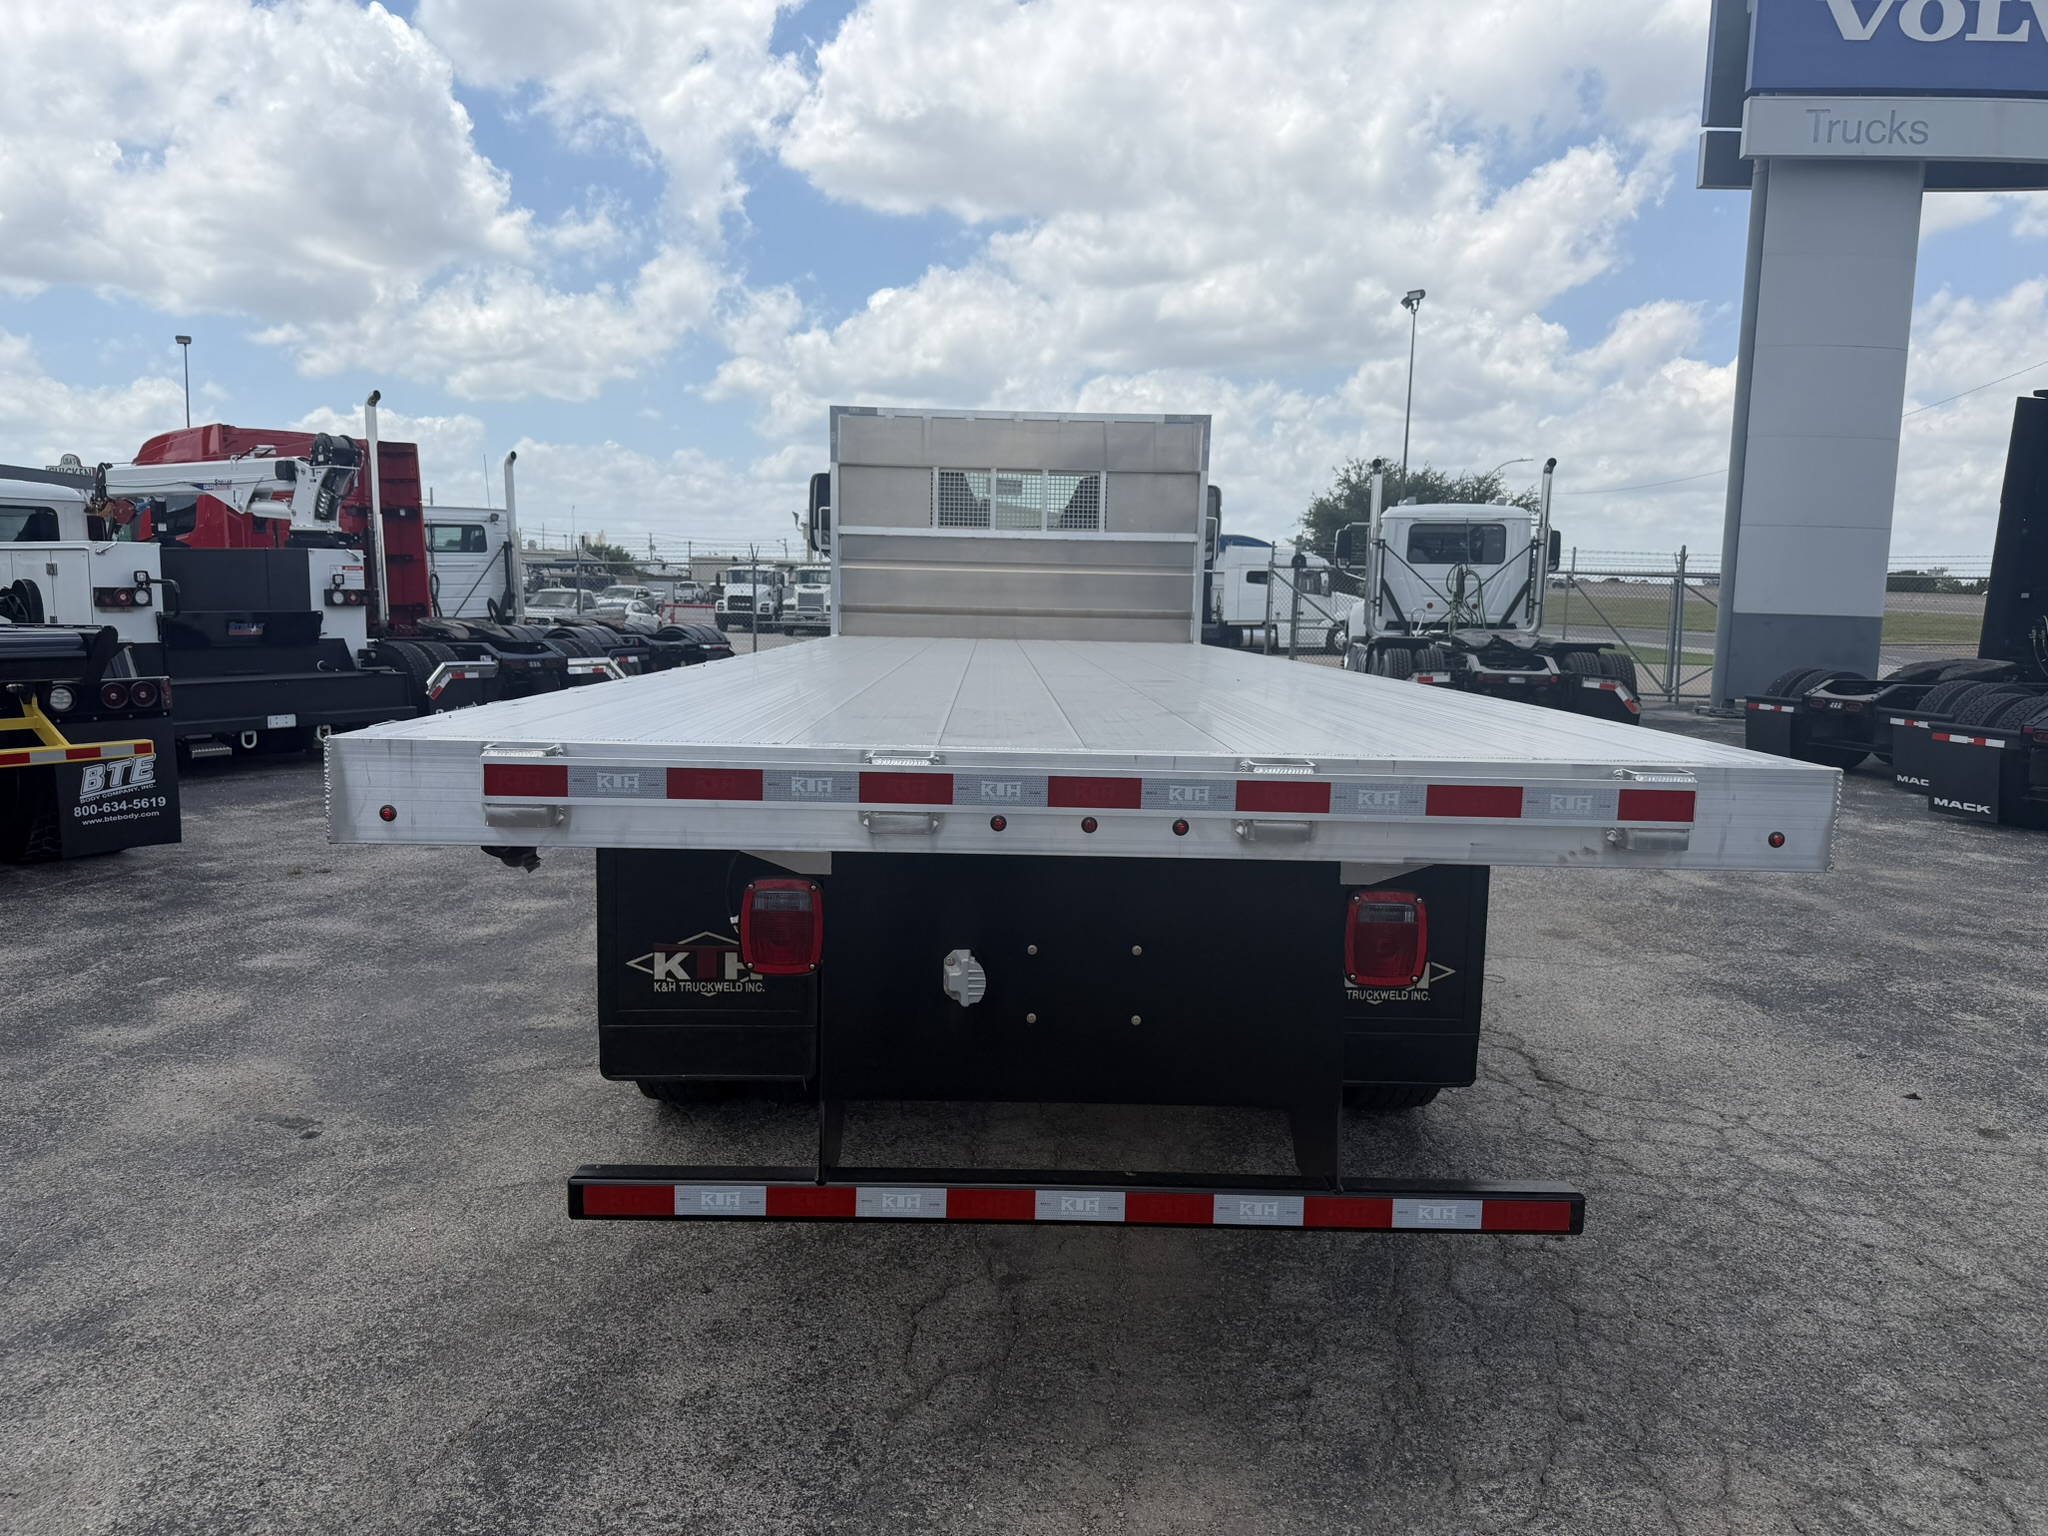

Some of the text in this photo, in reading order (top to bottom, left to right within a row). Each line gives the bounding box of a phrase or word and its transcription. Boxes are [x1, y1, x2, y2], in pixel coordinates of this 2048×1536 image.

[1805, 108, 1930, 145] Trucks
[80, 753, 157, 796] BTE
[1896, 774, 1930, 787] MAC
[80, 783, 157, 804] BODY COMPANY, INC.
[74, 796, 167, 817] 800-634-5619
[1933, 797, 1991, 815] MACK
[82, 810, 160, 826] www.btebody.com
[653, 981, 766, 993] K&H TRUCKWELD INC.
[1346, 989, 1431, 1001] TRUCKWELD INC.
